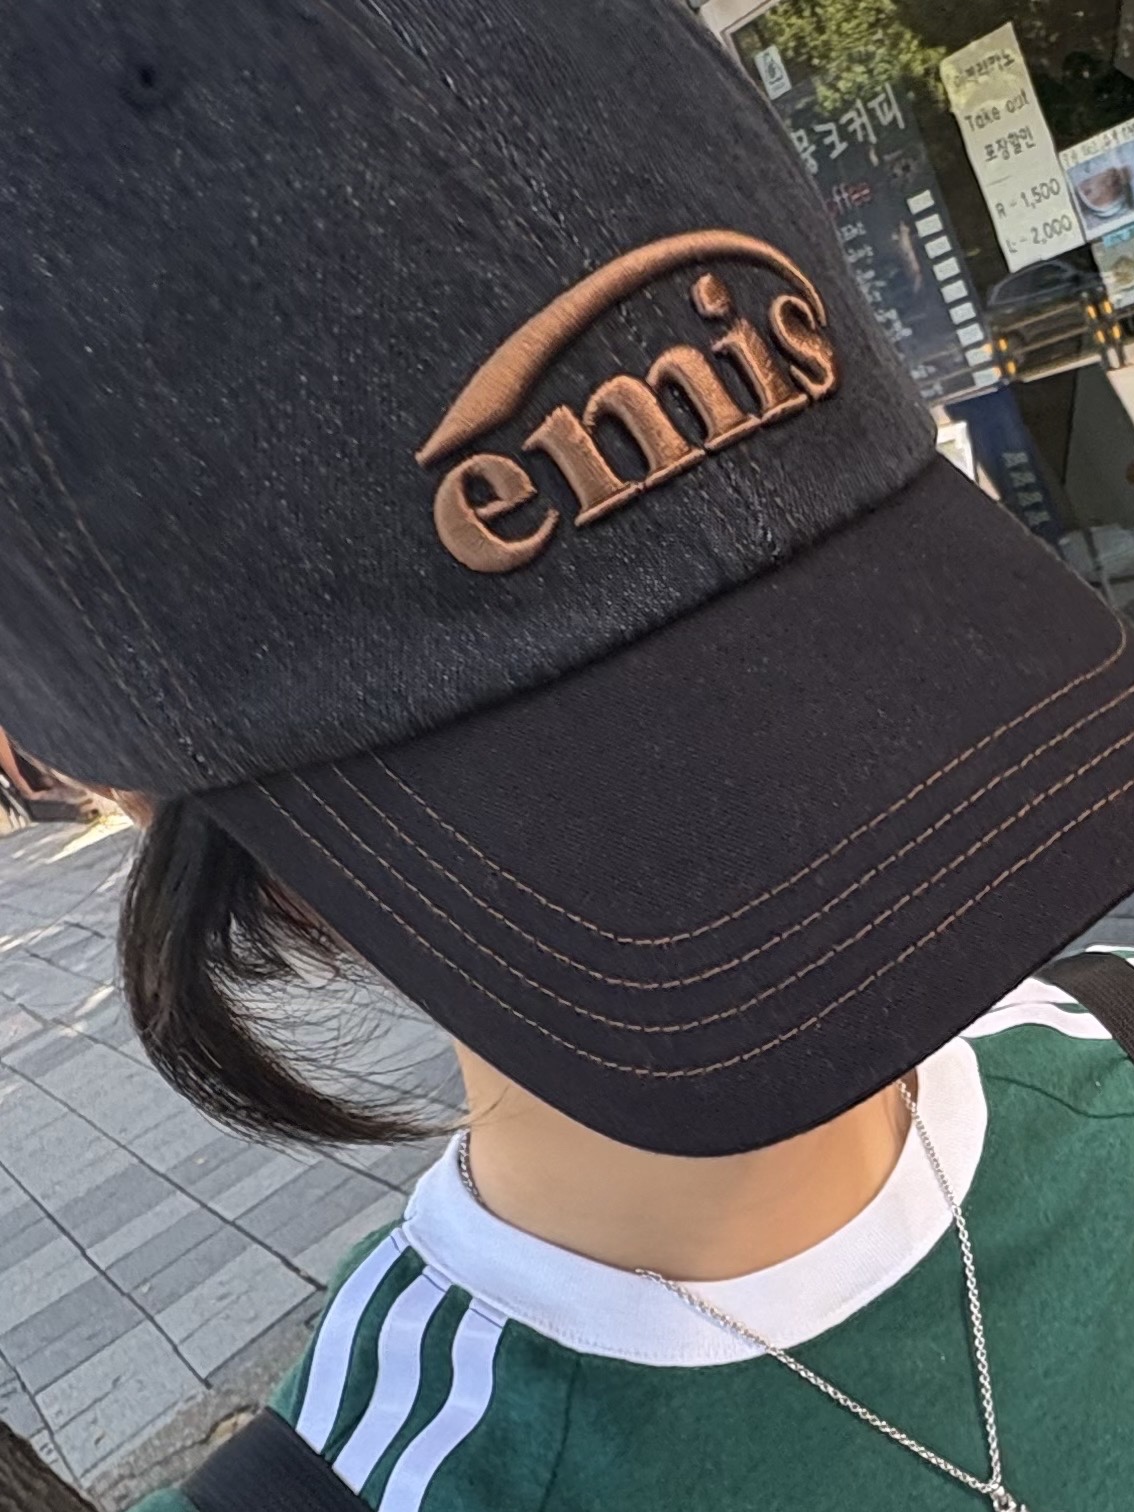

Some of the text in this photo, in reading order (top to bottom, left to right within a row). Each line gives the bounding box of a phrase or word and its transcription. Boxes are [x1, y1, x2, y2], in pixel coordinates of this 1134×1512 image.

[964, 88, 1030, 132] Take out
[433, 272, 837, 573] emis
